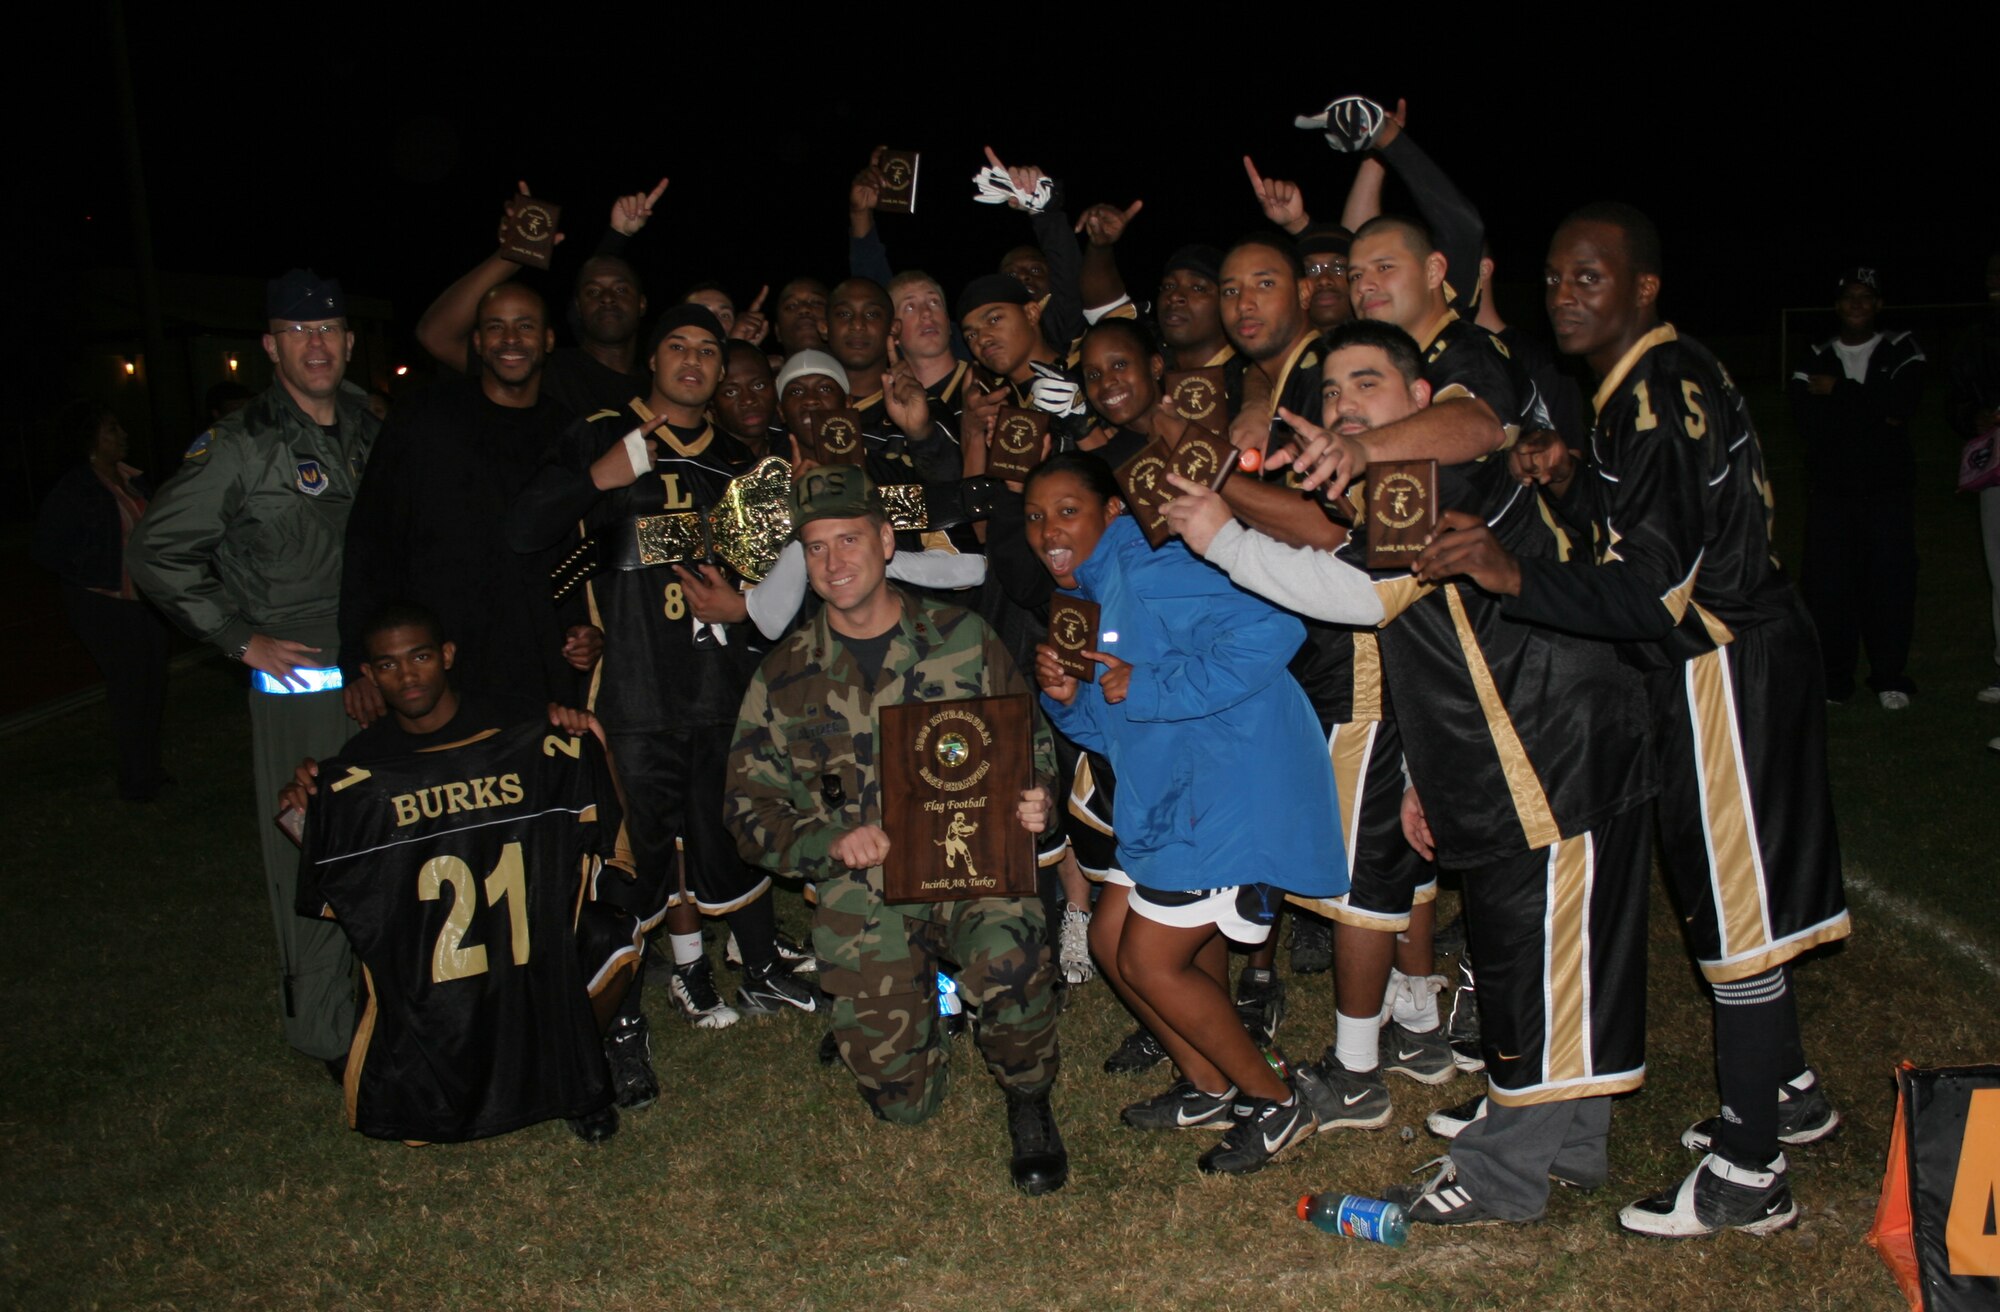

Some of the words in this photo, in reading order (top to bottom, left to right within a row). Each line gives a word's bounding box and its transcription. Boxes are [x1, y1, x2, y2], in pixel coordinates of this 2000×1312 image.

[660, 473, 693, 511] L
[663, 582, 687, 621] 8
[929, 709, 993, 747] INTRAMURAL
[918, 766, 944, 790] BASE
[943, 759, 991, 792] CHAMPION
[391, 773, 525, 828] BURKS
[923, 799, 945, 813] Flag
[946, 796, 988, 810] Football
[920, 878, 950, 889] Incirlik
[968, 876, 997, 888] Turkey
[417, 841, 531, 984] 21
